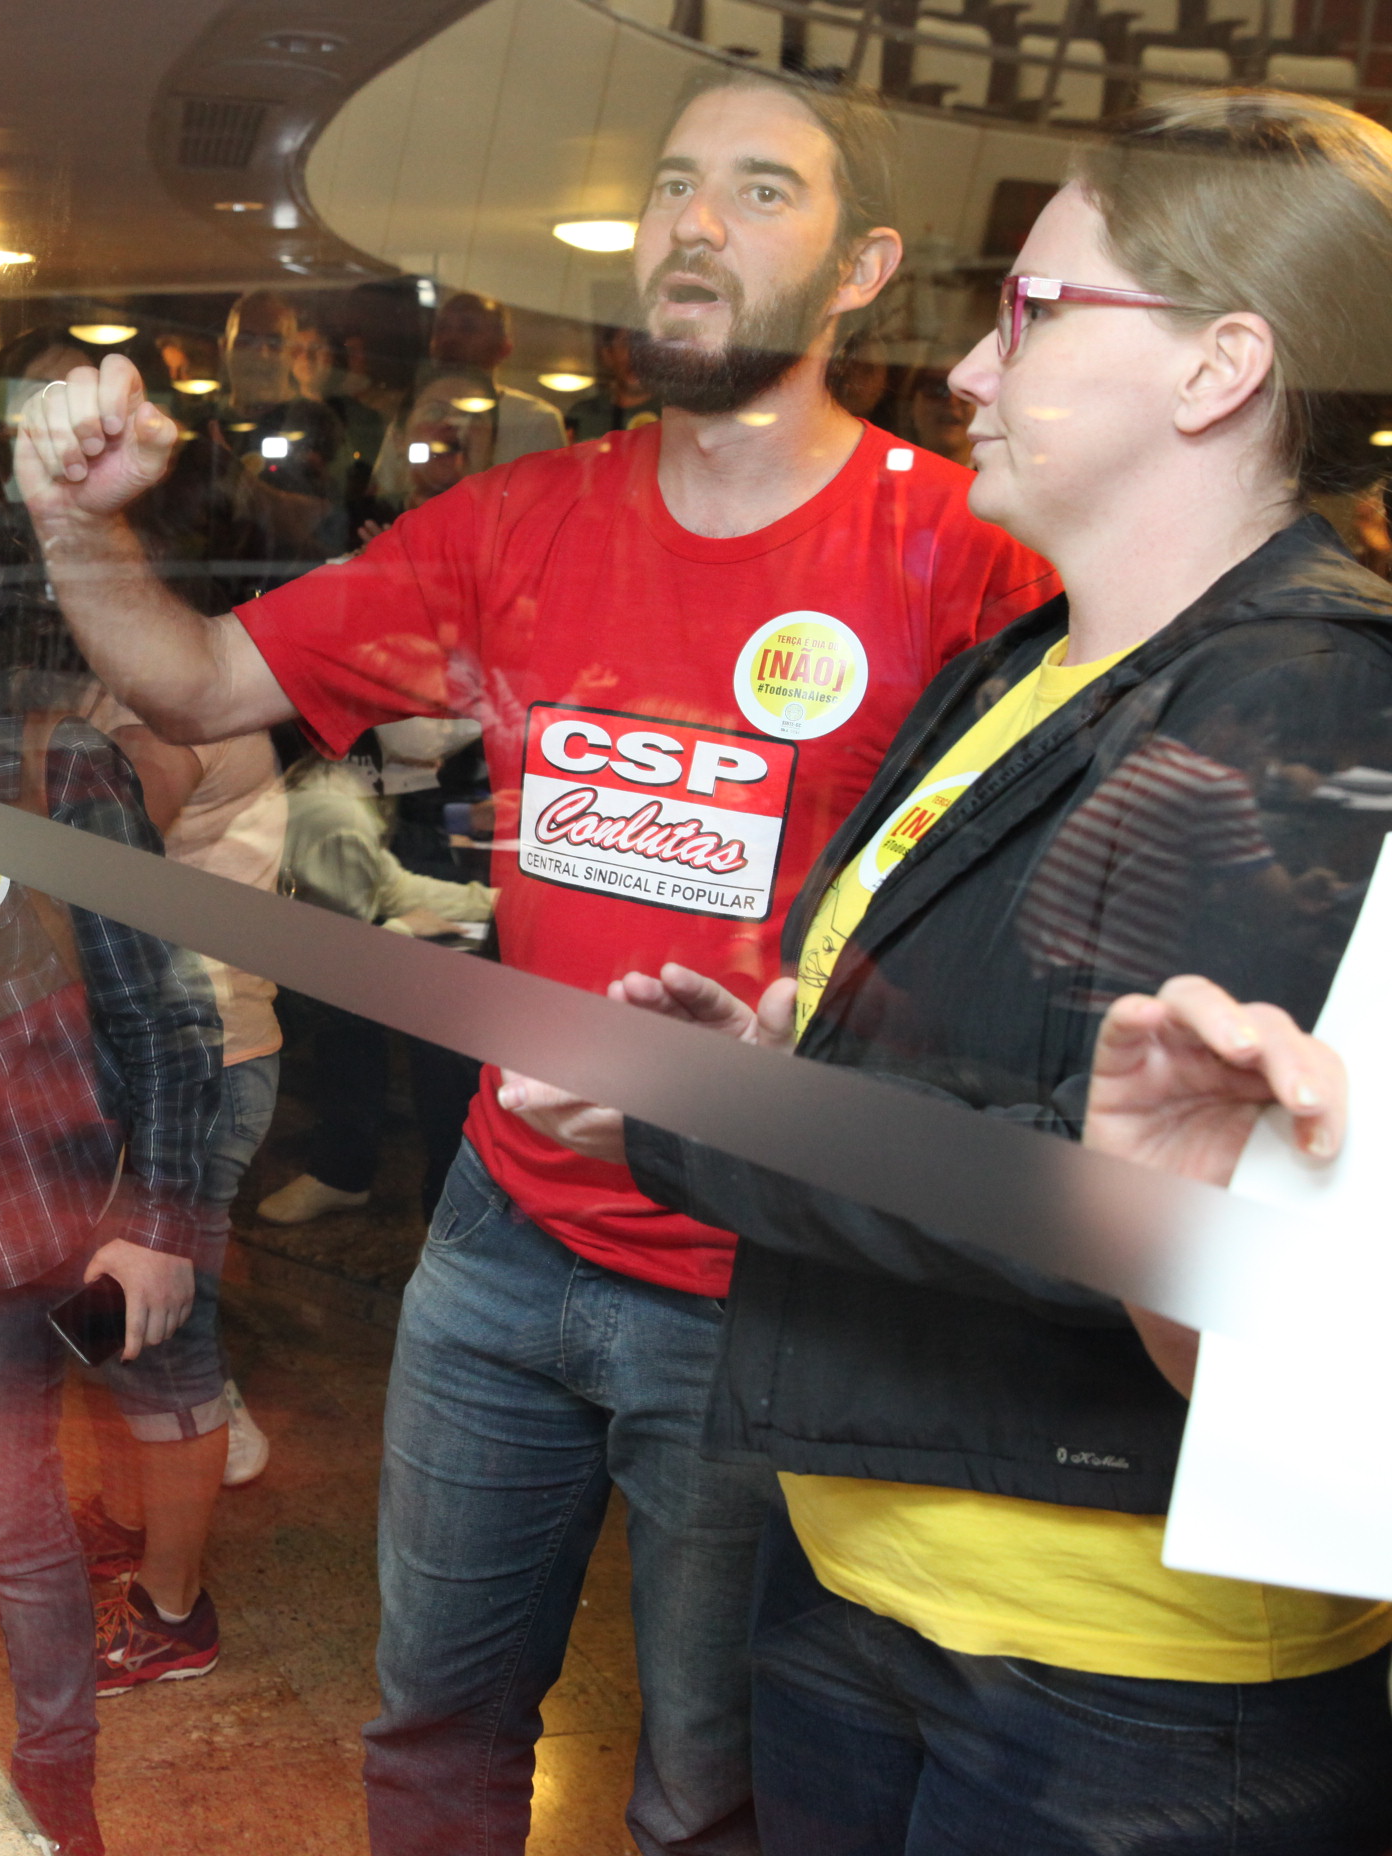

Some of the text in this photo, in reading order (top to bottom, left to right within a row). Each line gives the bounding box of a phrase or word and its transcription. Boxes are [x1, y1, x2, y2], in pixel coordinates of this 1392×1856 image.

[777, 635, 802, 647] TERÇA
[811, 639, 825, 649] DIA
[757, 648, 847, 692] [NÃO]
[757, 683, 839, 704] #TodosNaAlesc
[540, 719, 770, 798] CSP
[535, 787, 748, 874] Conlutas
[891, 806, 936, 841] [N
[527, 852, 756, 911] CENTRAL SINDICAL E POPULAR
